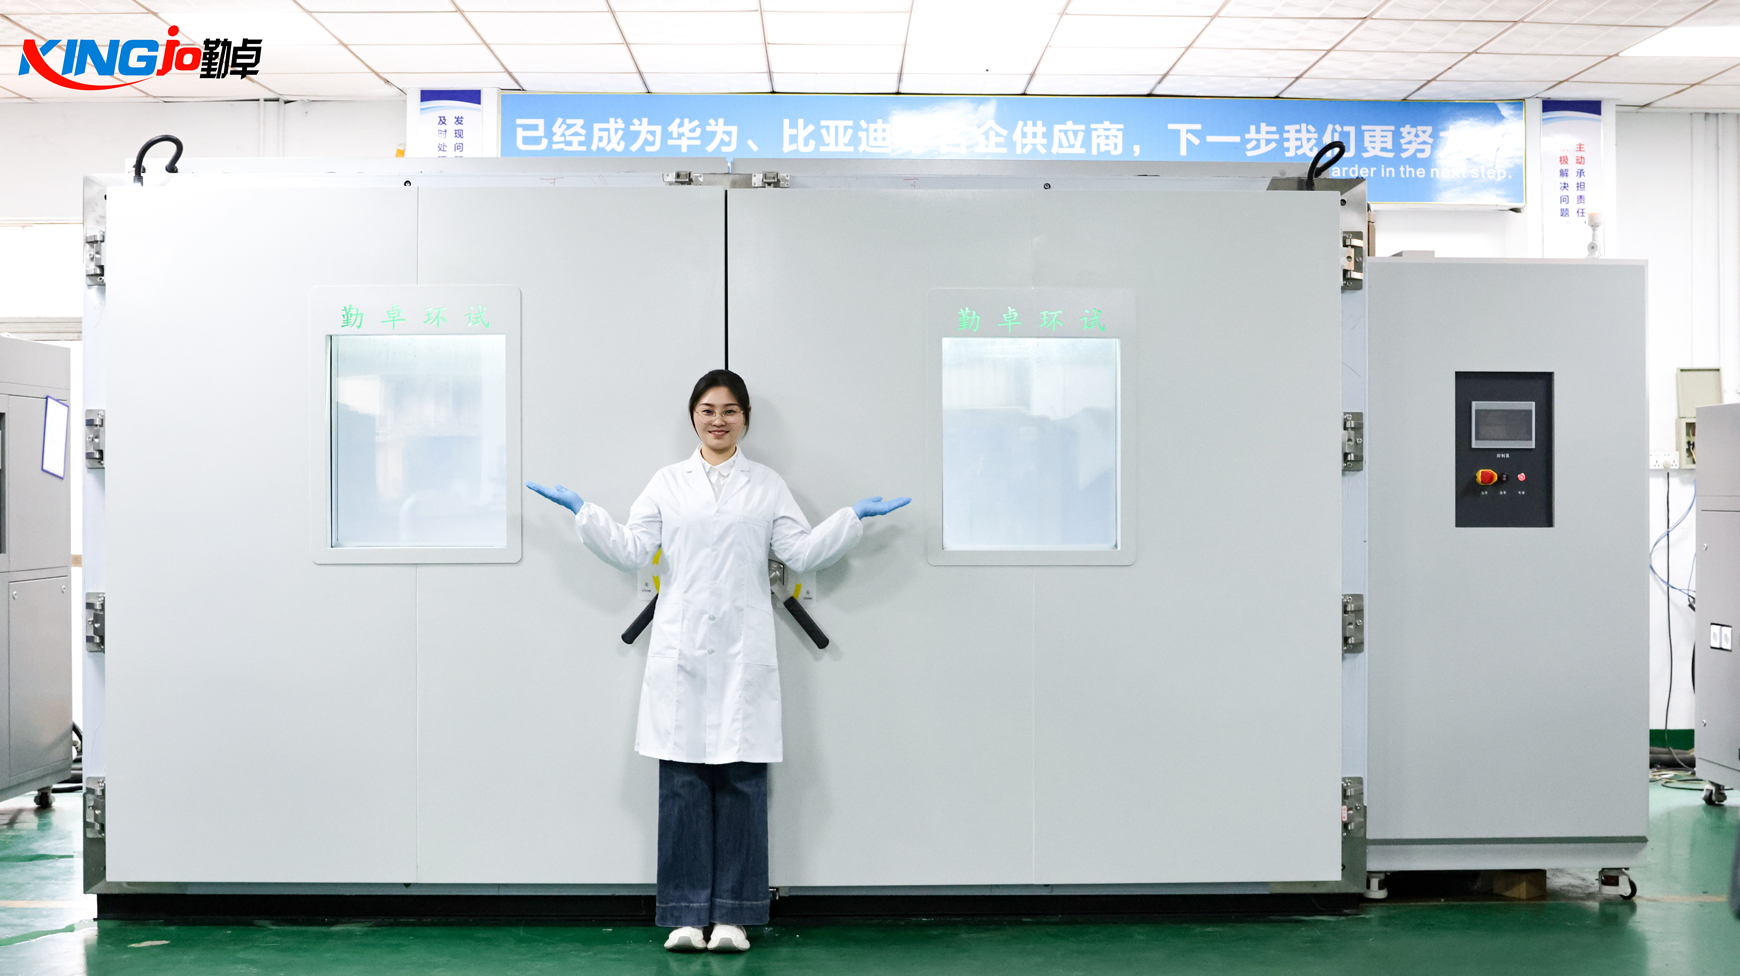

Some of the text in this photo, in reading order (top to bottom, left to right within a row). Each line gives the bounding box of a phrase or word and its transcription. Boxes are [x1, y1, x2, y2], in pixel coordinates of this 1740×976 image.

[437, 115, 448, 158] 及时处
[453, 115, 465, 158] 发现问
[1331, 164, 1513, 181] arder in the next step.
[340, 303, 491, 330] 勤卓环试
[957, 306, 1106, 333] 勤卓环试
